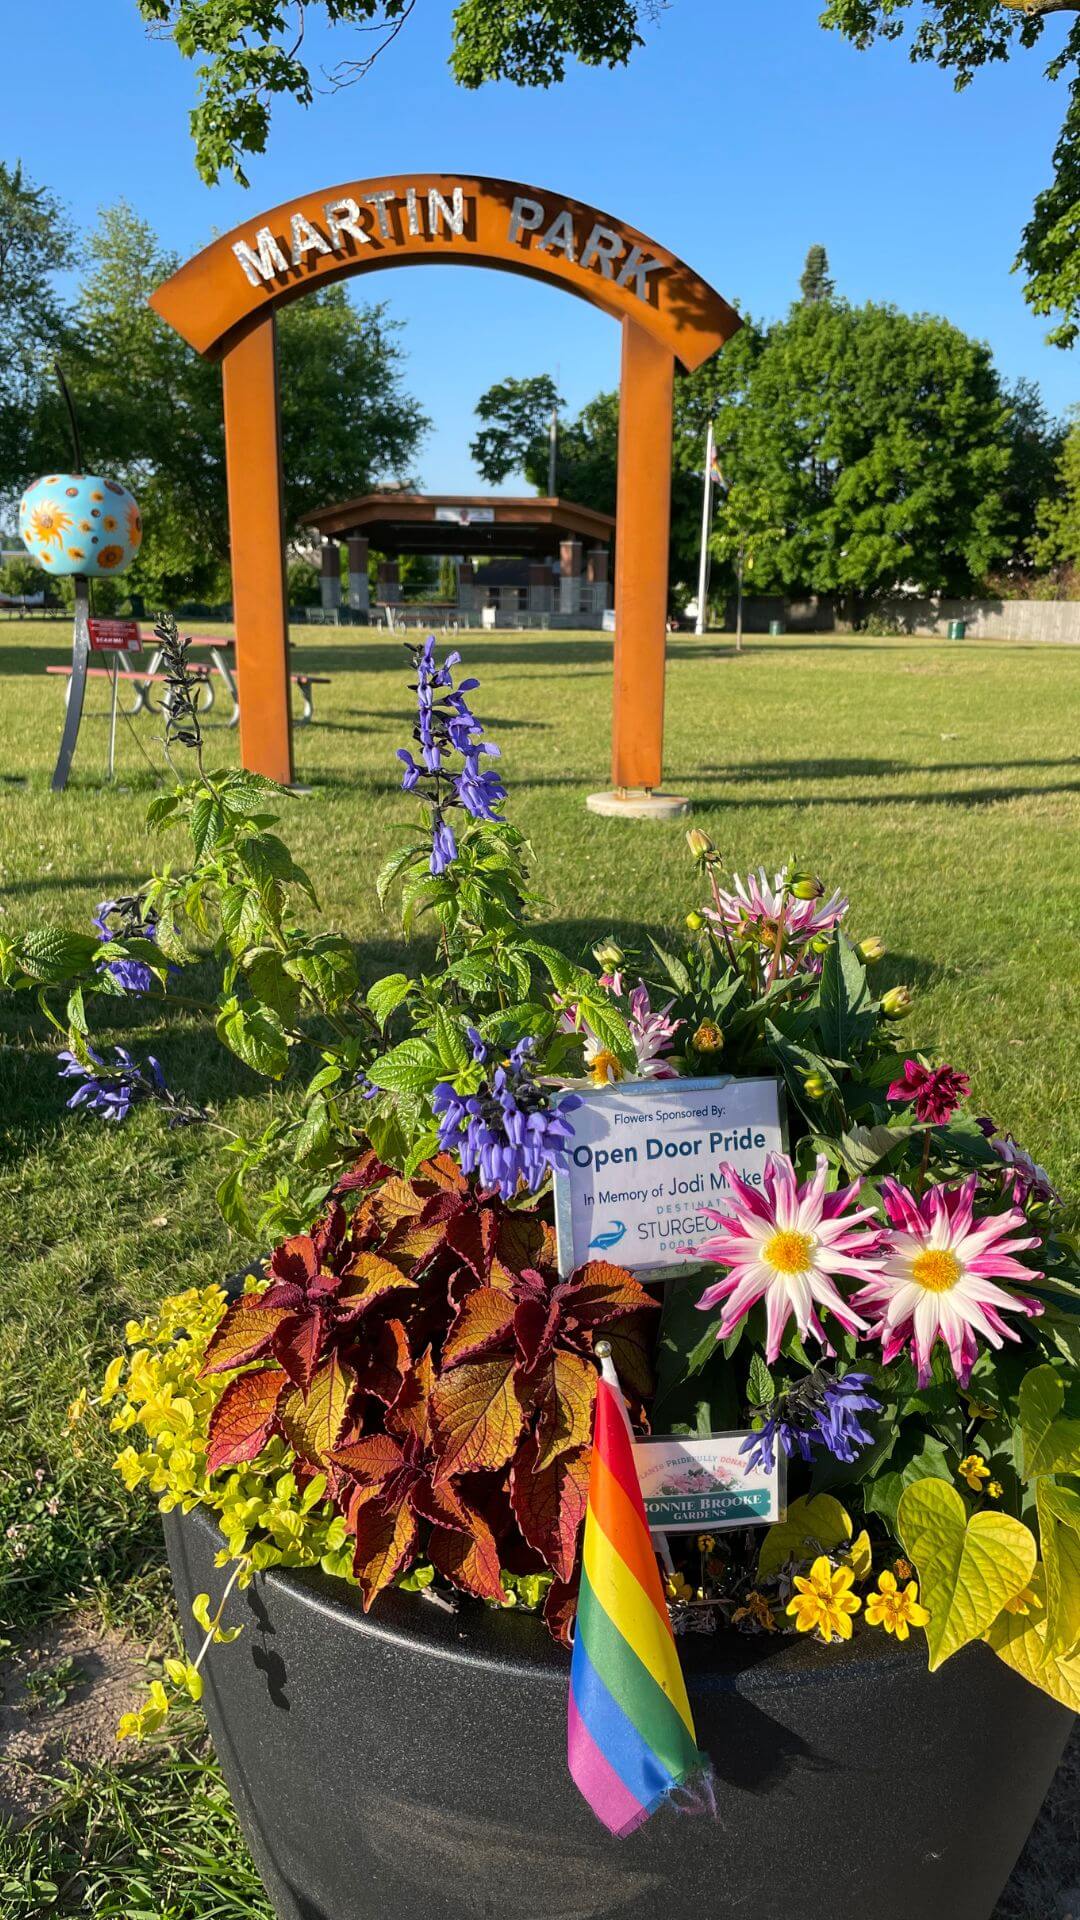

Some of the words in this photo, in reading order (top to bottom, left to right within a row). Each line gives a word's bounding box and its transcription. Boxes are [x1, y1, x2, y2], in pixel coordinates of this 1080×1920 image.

[232, 187, 464, 287] MARTIN
[507, 196, 665, 301] PARK
[614, 1113, 653, 1125] Flowers
[656, 1107, 708, 1122] Sponsored
[711, 1106, 726, 1118] By:
[573, 1146, 638, 1173] Open
[646, 1138, 702, 1160] Door
[710, 1127, 766, 1153] Pride
[584, 1193, 595, 1206] In
[599, 1188, 649, 1205] Memory
[651, 1184, 664, 1198] of
[668, 1173, 705, 1196] Jodi
[673, 1508, 727, 1521] GARDENS
[700, 1494, 762, 1510] BROOKE
